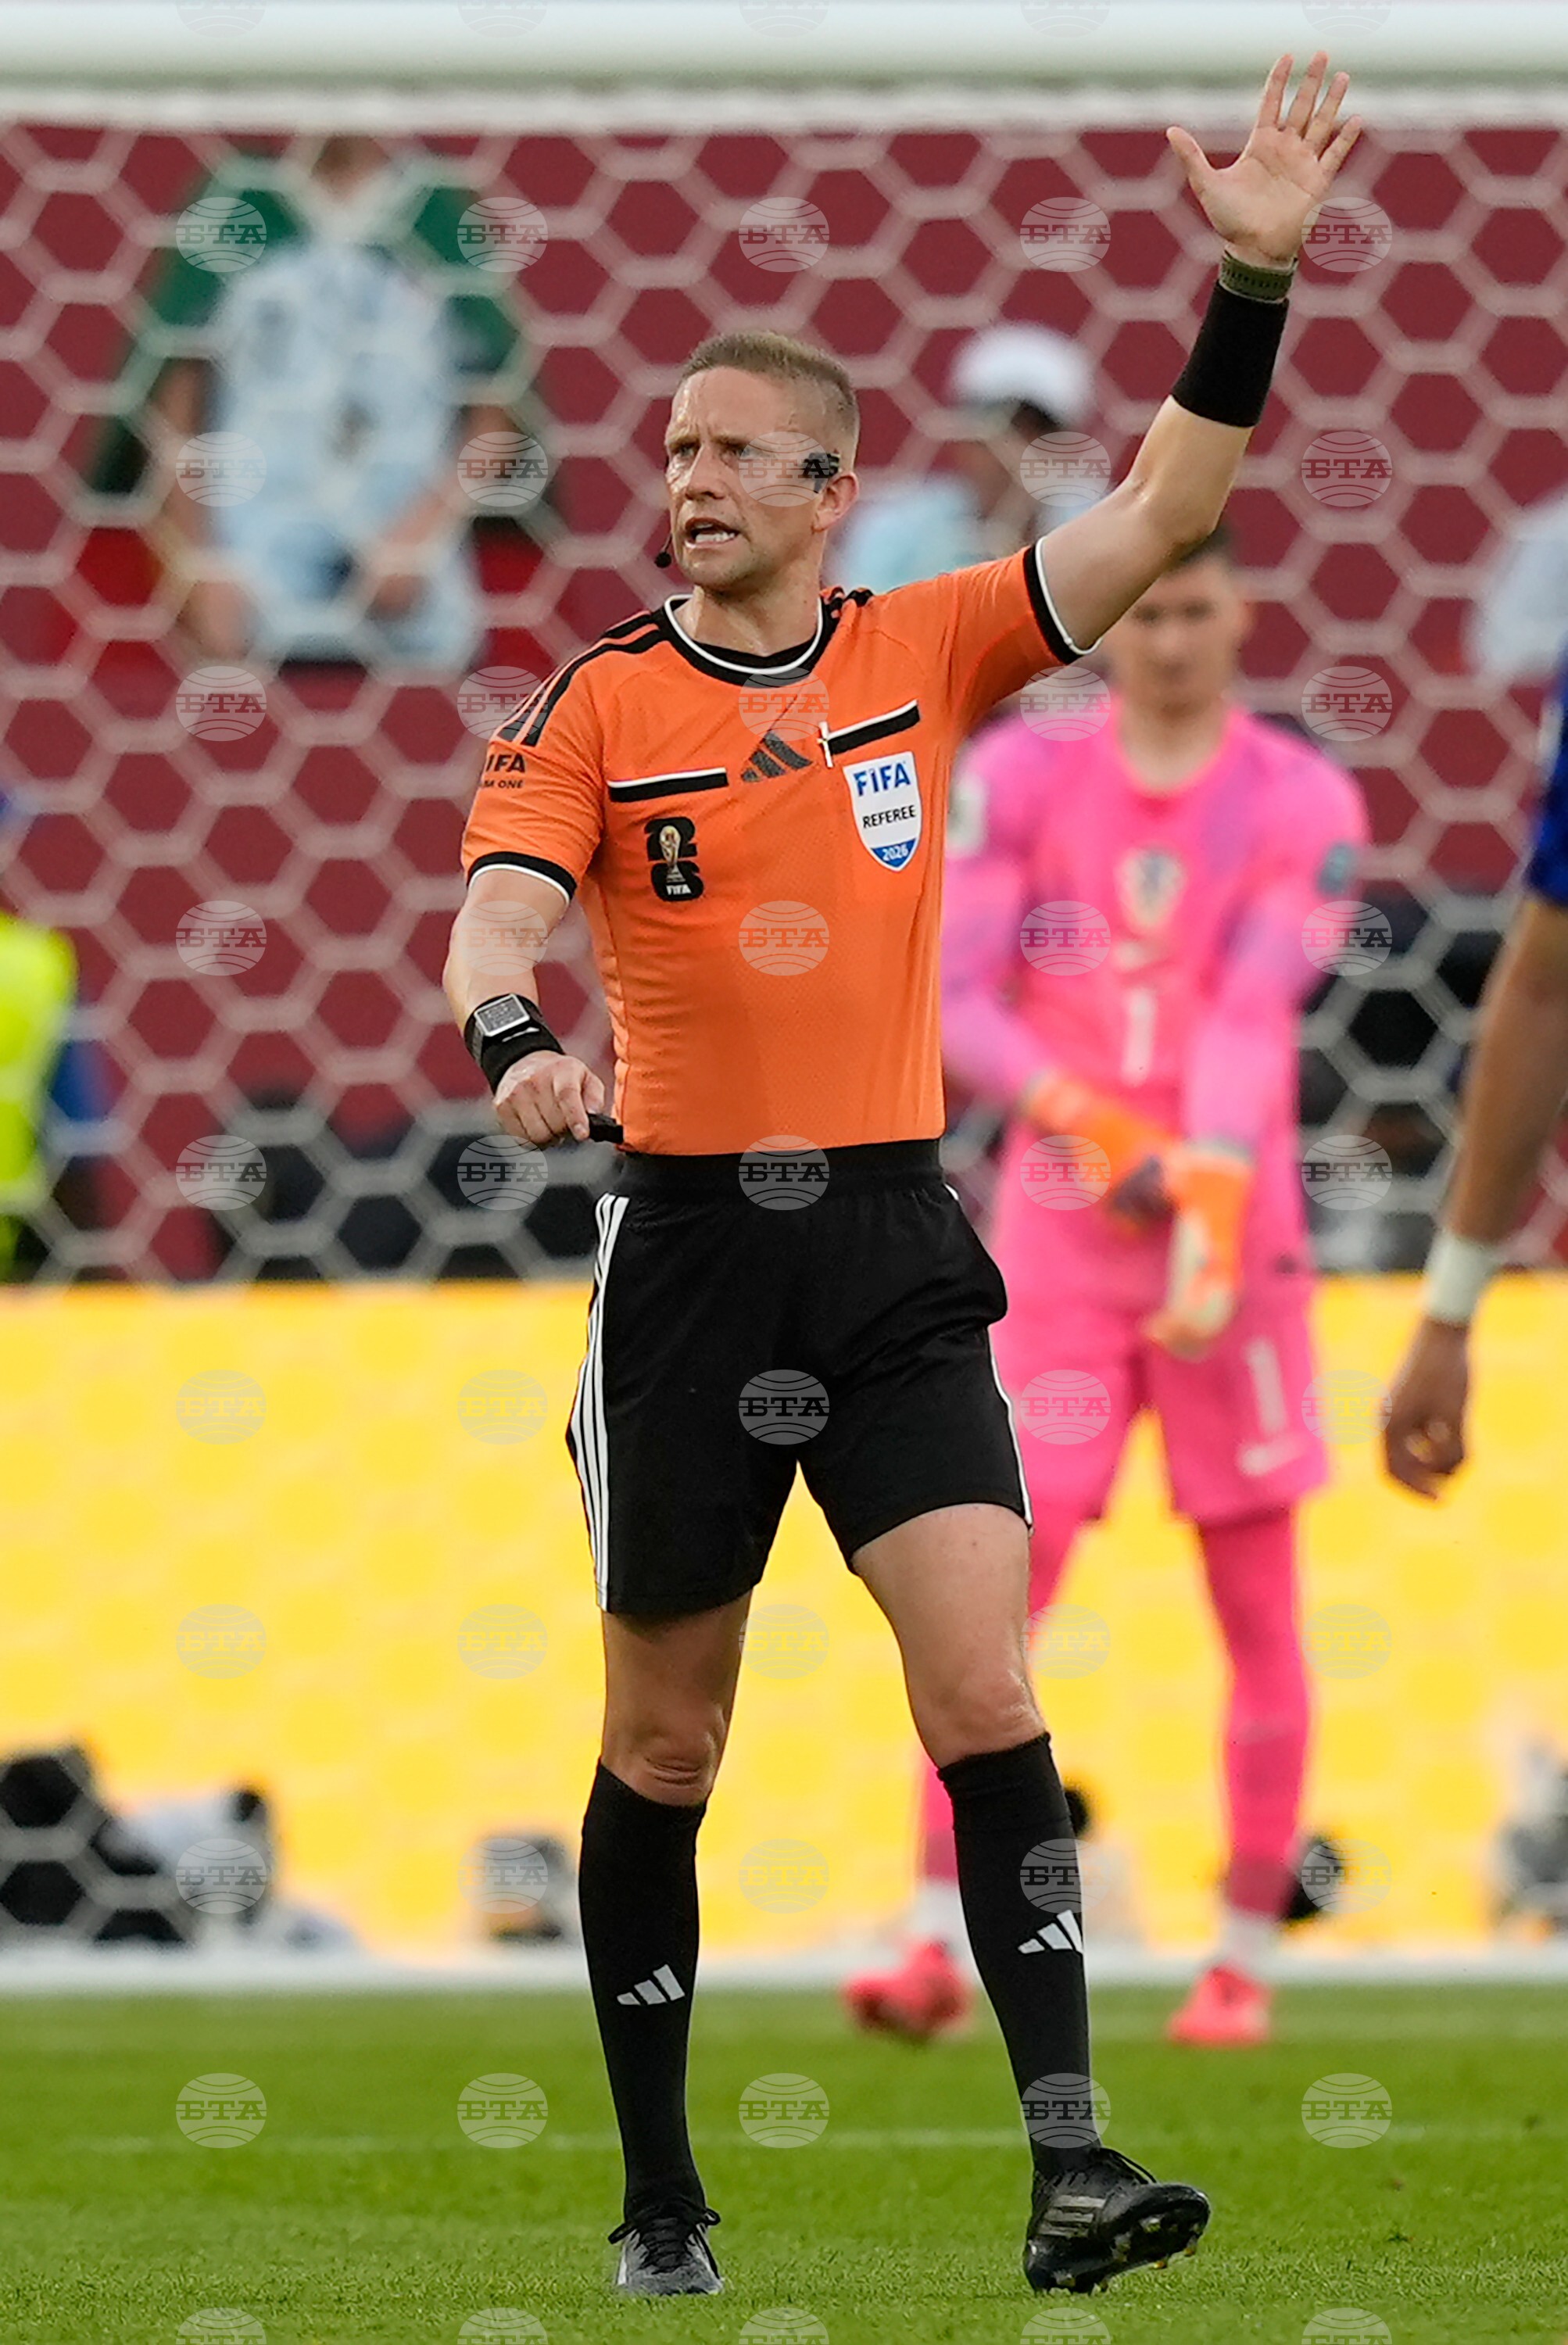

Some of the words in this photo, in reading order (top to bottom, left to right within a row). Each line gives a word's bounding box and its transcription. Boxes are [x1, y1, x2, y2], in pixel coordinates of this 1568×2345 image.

[485, 753, 525, 773] IFA
[854, 761, 911, 797] FIFA
[862, 805, 916, 829] REFEREE
[882, 844, 909, 861] 2026
